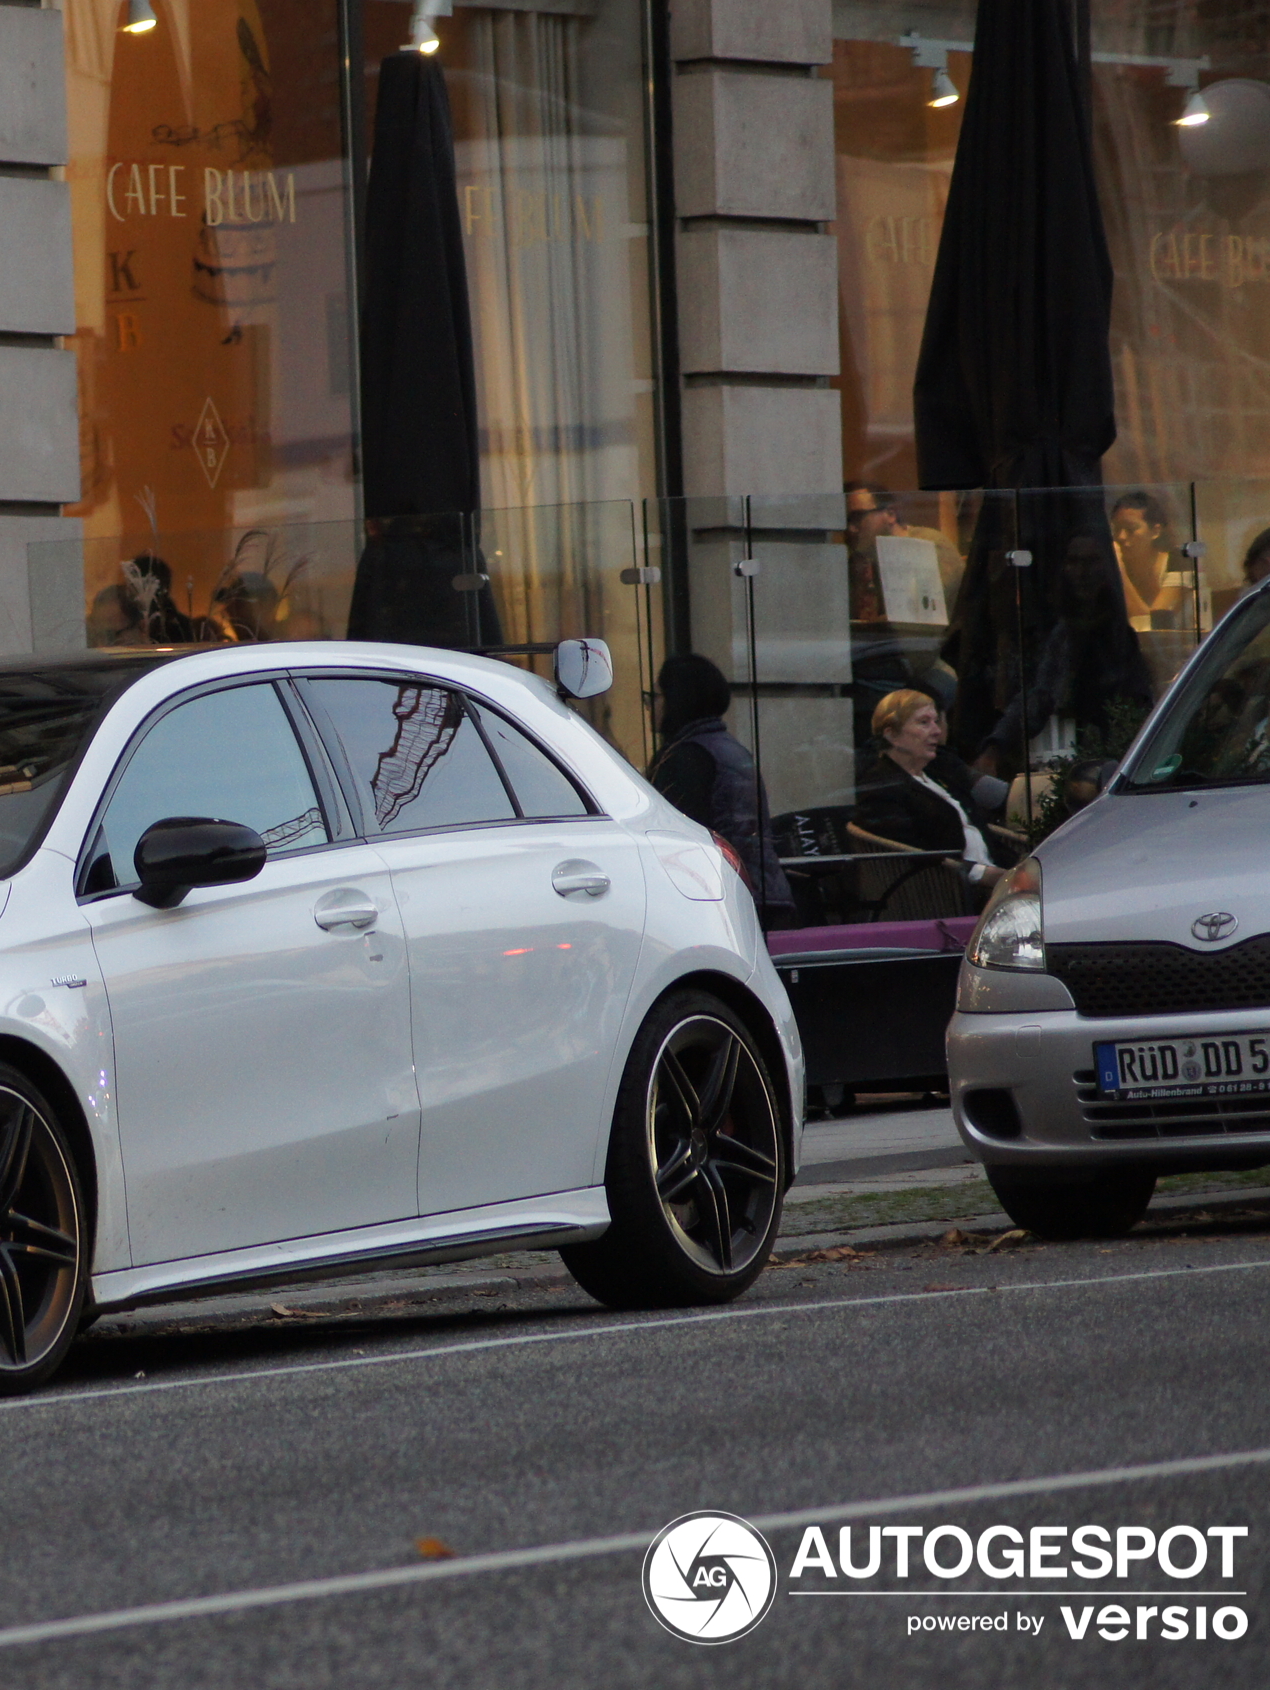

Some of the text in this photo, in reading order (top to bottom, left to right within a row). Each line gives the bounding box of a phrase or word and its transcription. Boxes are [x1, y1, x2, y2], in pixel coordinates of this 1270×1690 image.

[107, 162, 297, 226] CAFE BLUM
[108, 249, 140, 291] K
[1149, 231, 1216, 284] CAFE
[1202, 1041, 1242, 1077] DD
